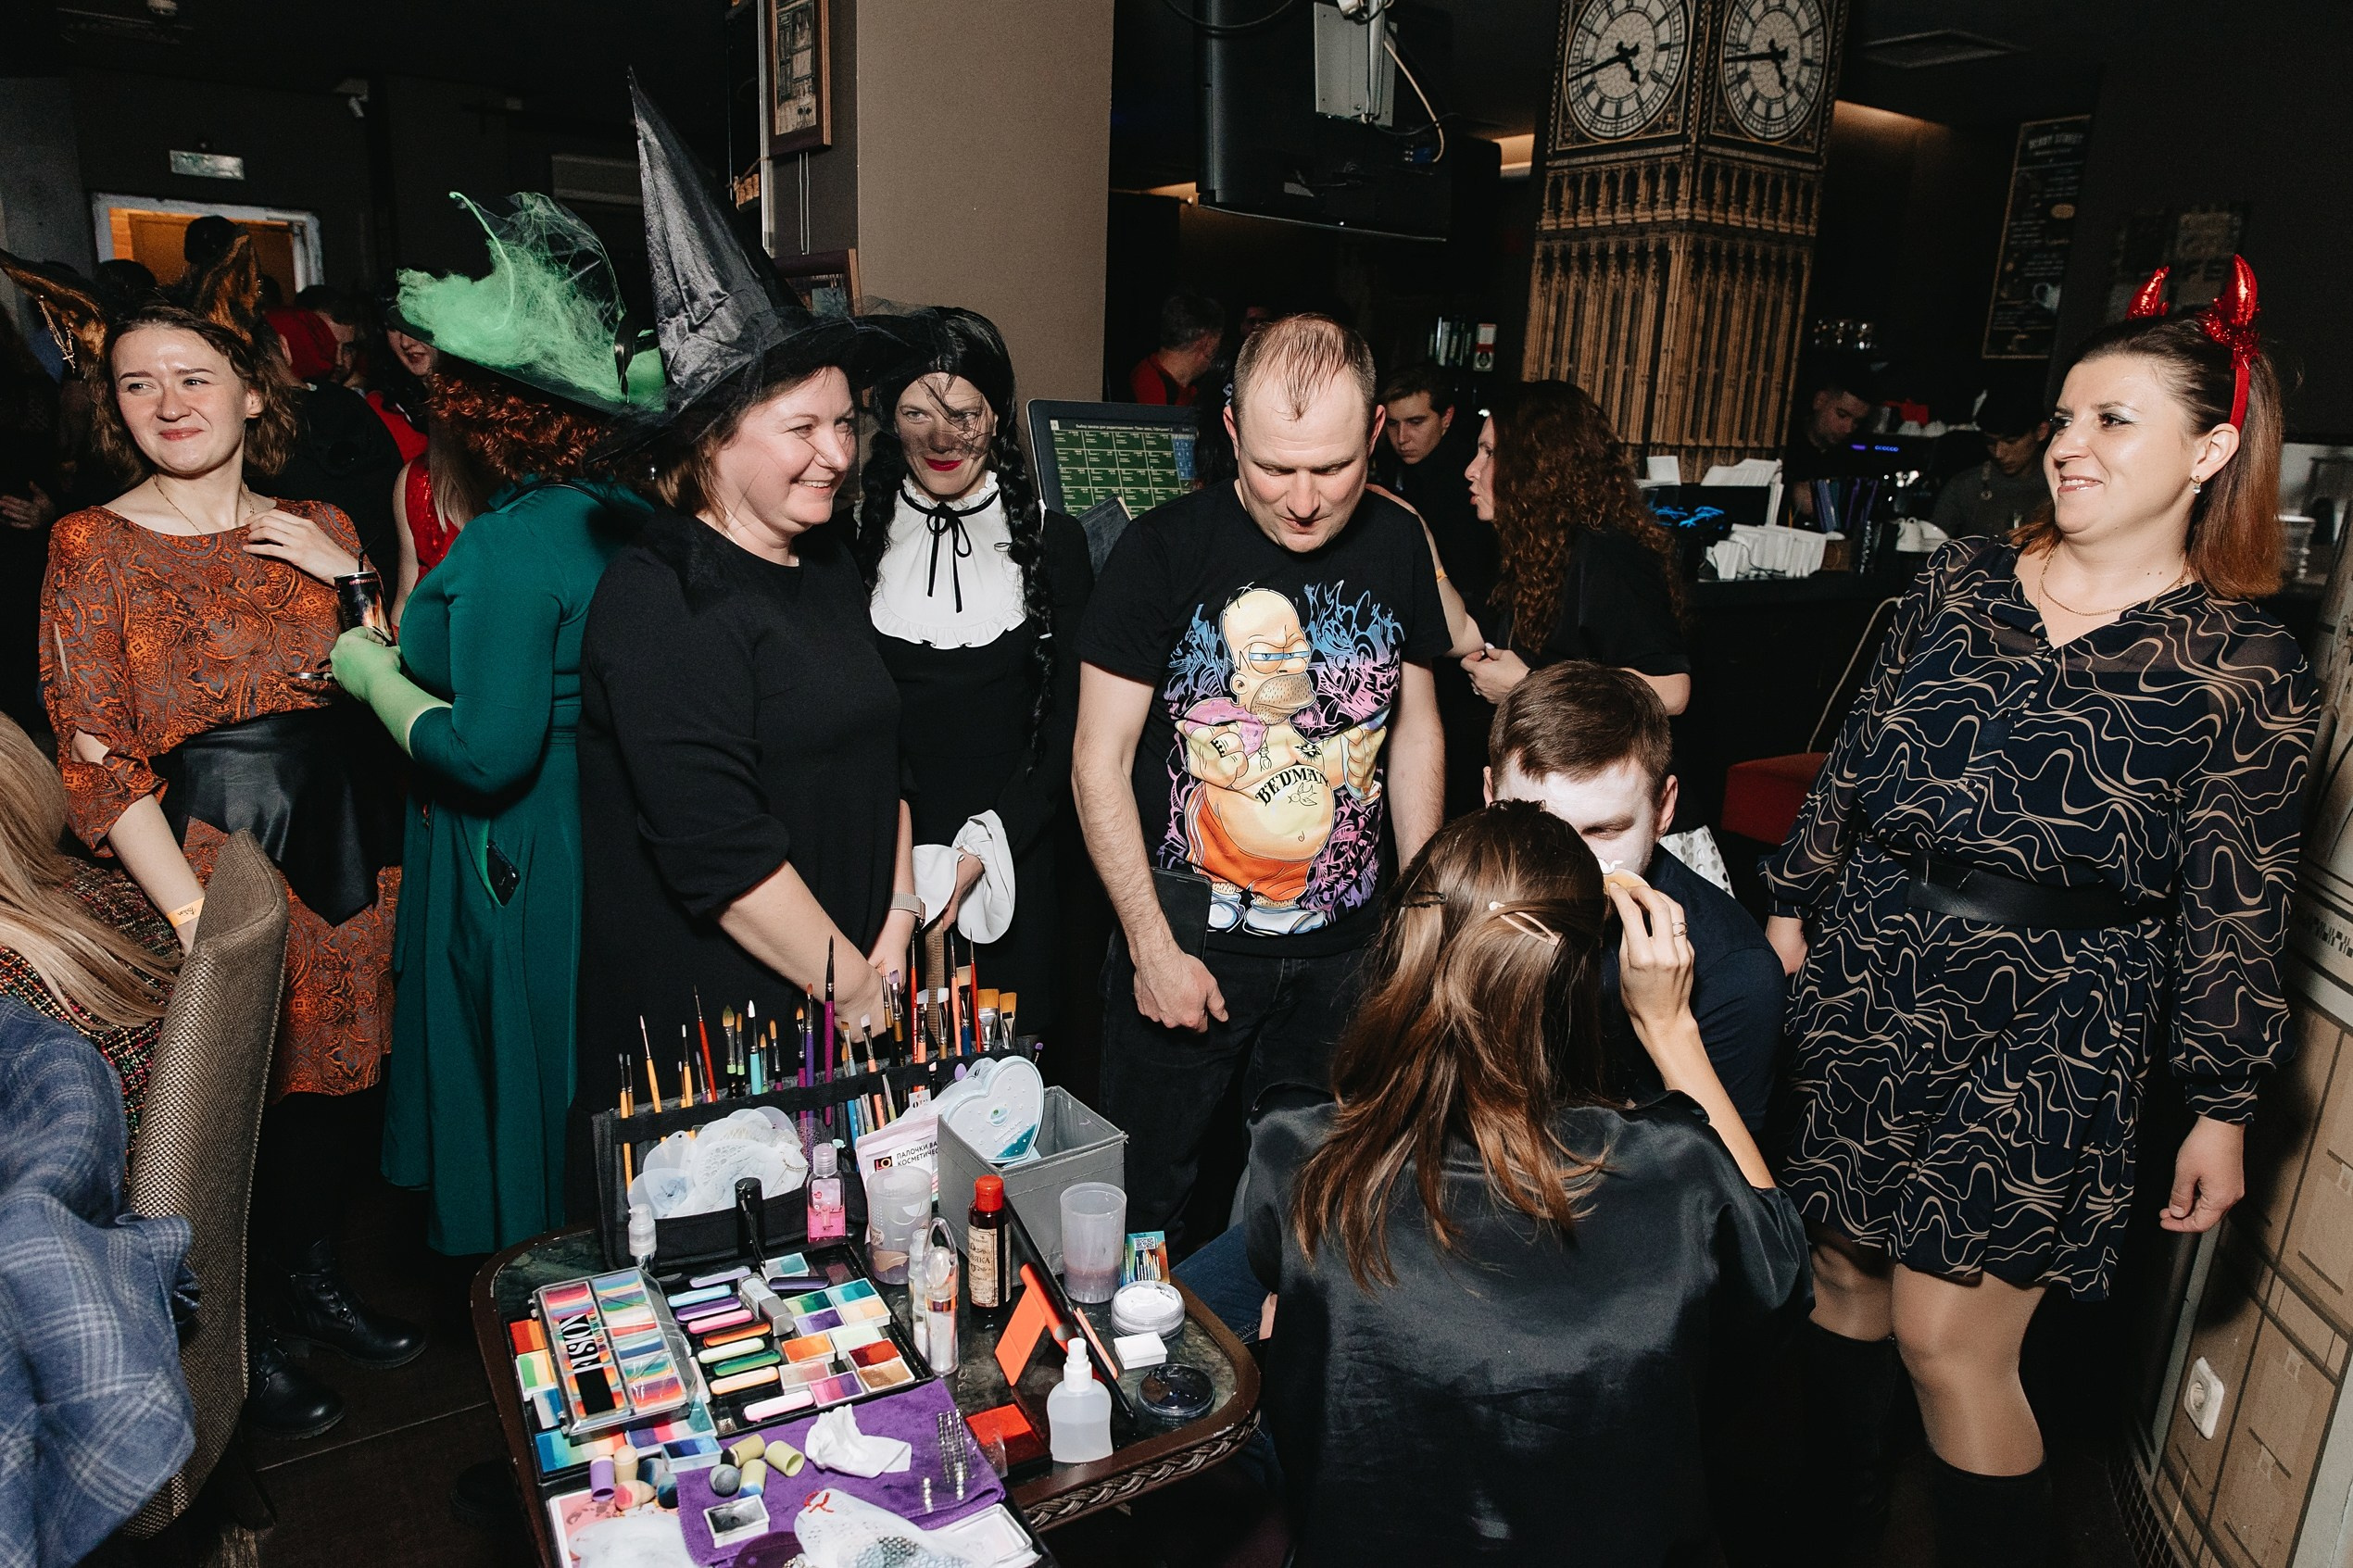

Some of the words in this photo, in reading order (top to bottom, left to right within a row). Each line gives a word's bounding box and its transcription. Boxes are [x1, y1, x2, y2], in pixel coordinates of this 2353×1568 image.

[1255, 767, 1328, 807] BEDMAN
[897, 1144, 927, 1159] ПАЛОЧКИ
[560, 1312, 605, 1374] FUSION
